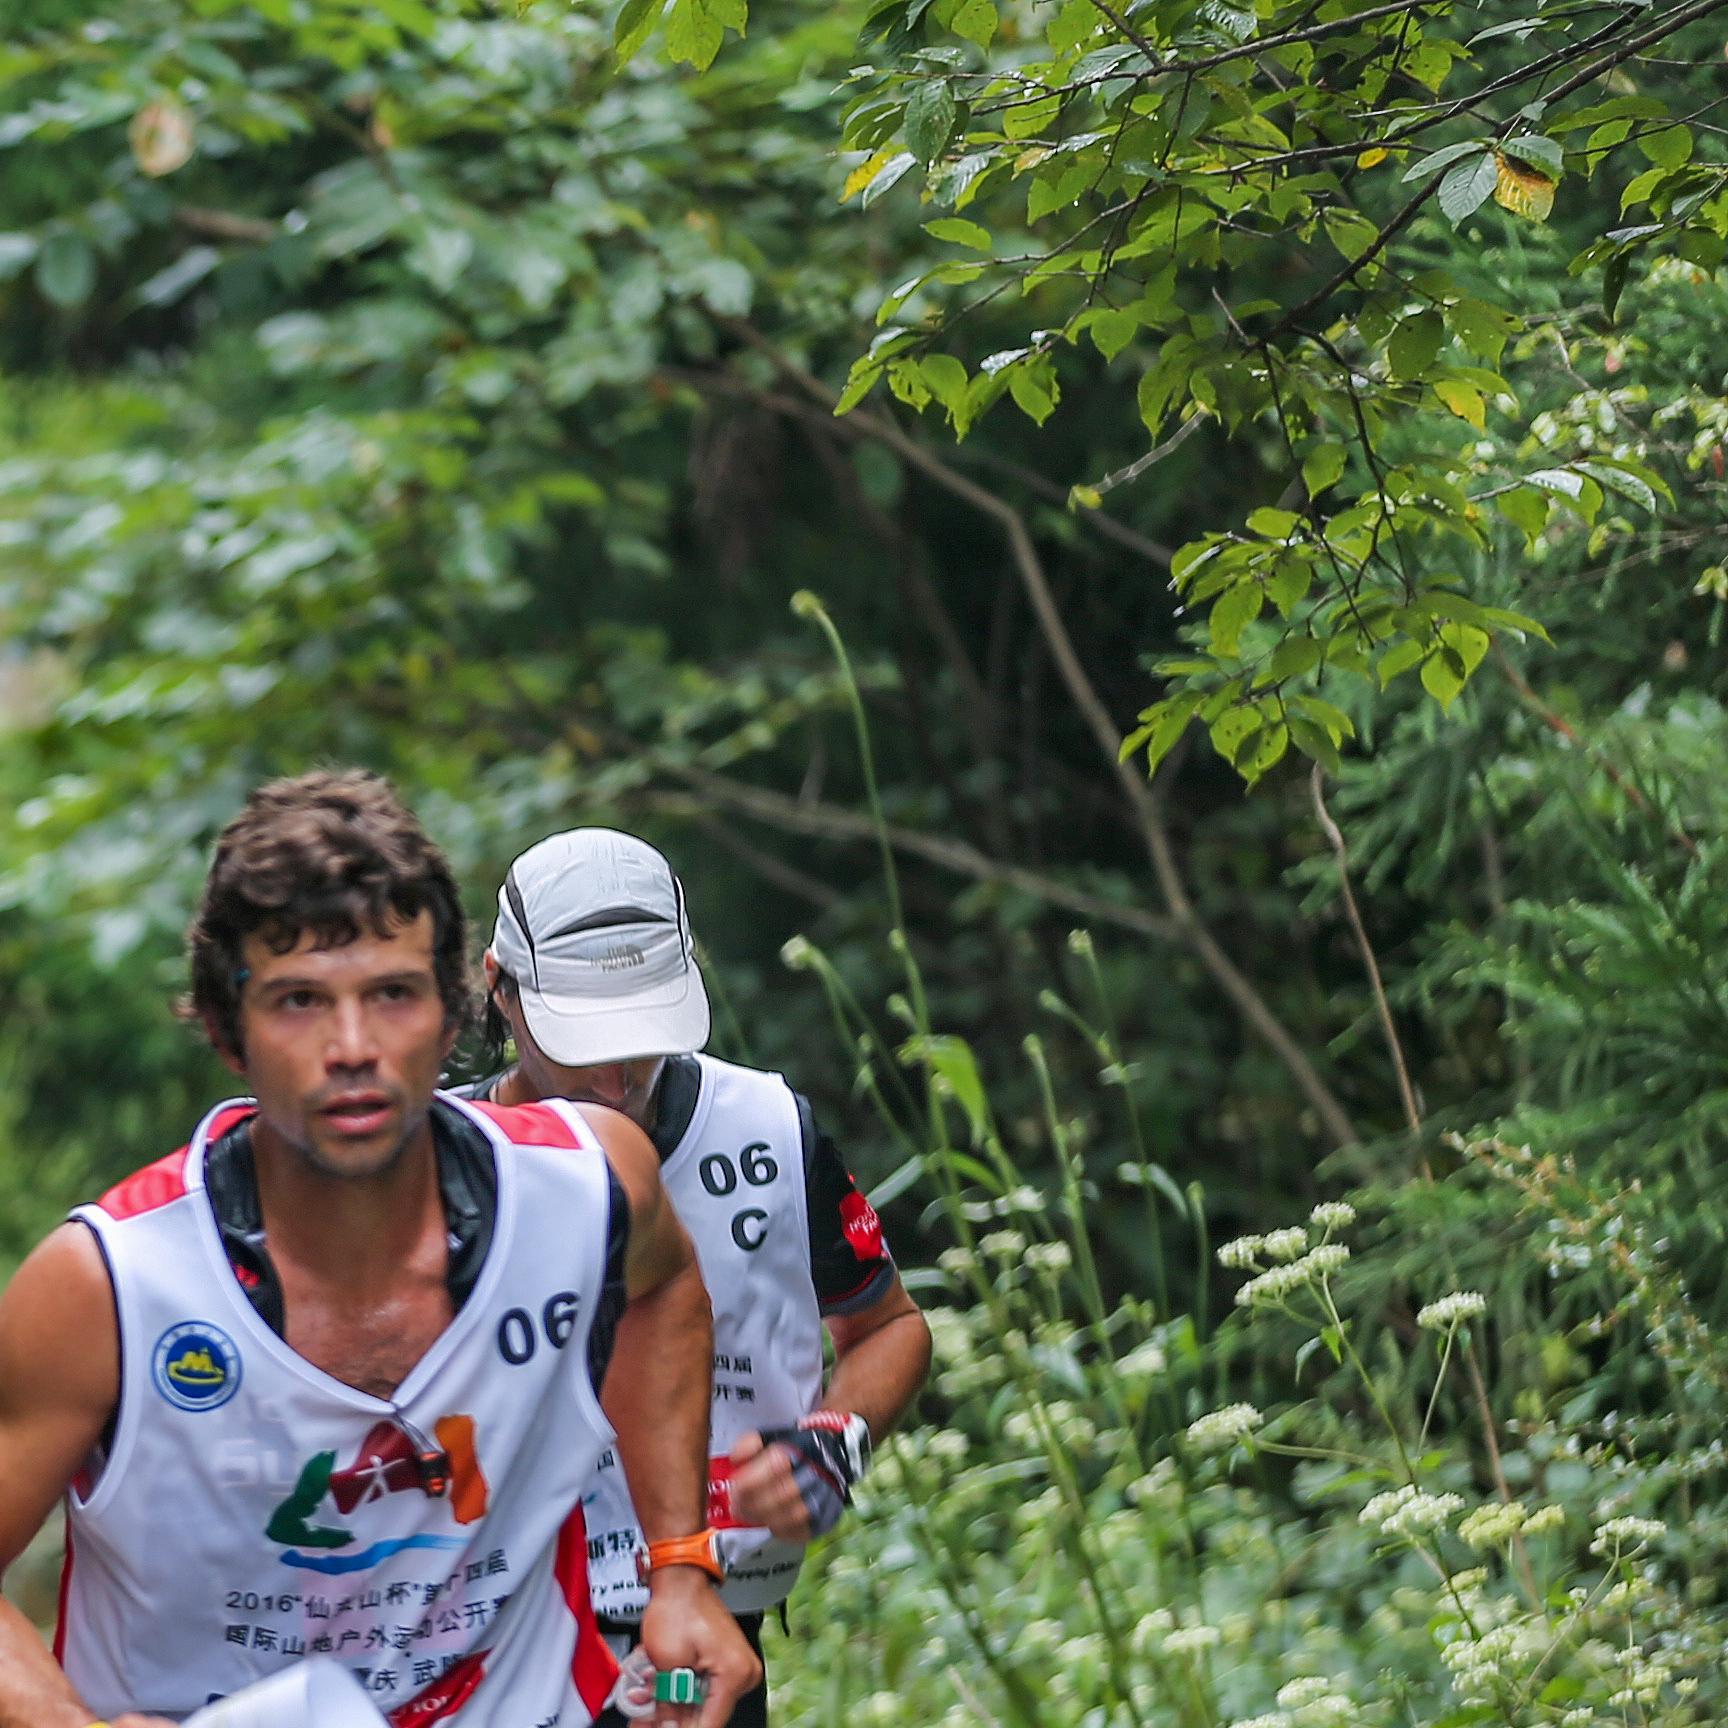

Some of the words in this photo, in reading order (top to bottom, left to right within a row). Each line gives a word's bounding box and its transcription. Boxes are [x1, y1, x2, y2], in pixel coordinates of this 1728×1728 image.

[698, 1141, 779, 1196] 06
[730, 1208, 769, 1252] C
[497, 1291, 581, 1364] 06
